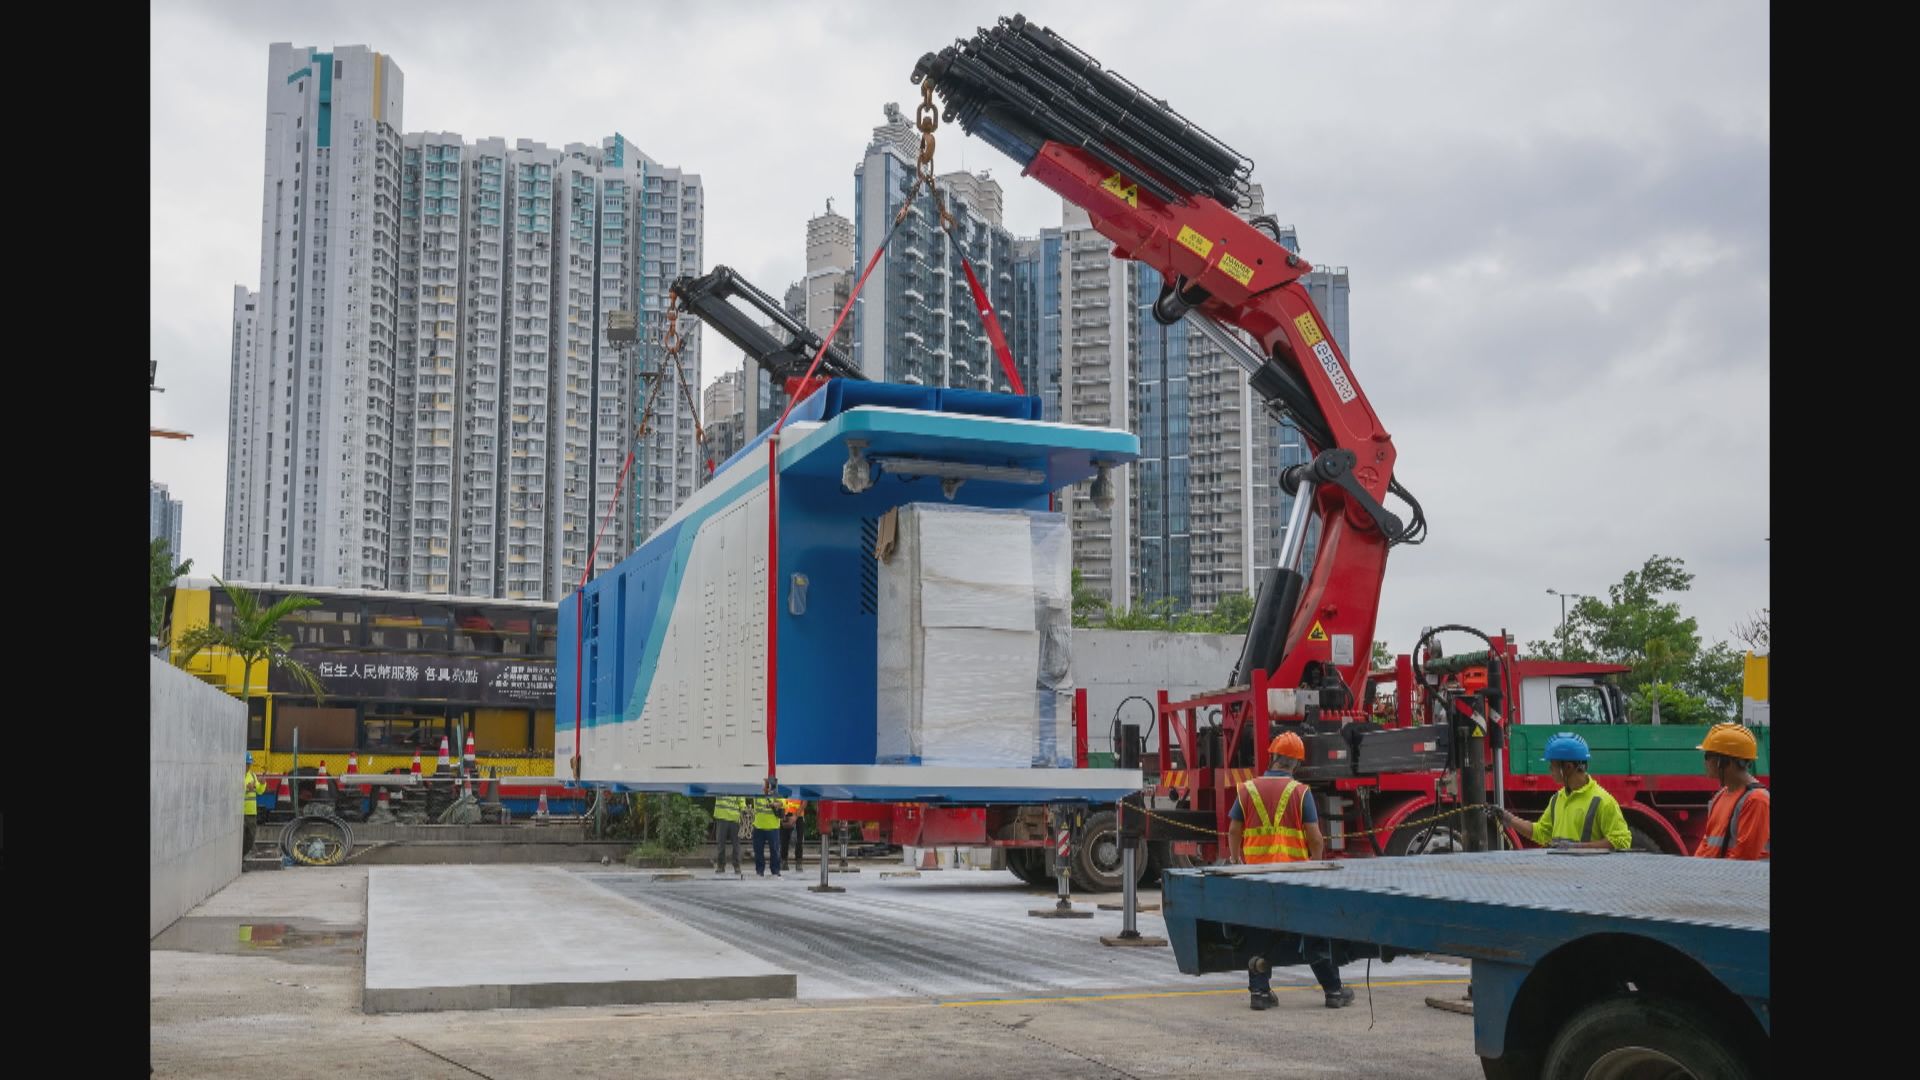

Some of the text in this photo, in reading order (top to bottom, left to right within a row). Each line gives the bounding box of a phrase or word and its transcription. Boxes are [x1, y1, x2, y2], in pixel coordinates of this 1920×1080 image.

[319, 662, 419, 681] 恒生人民幣服務
